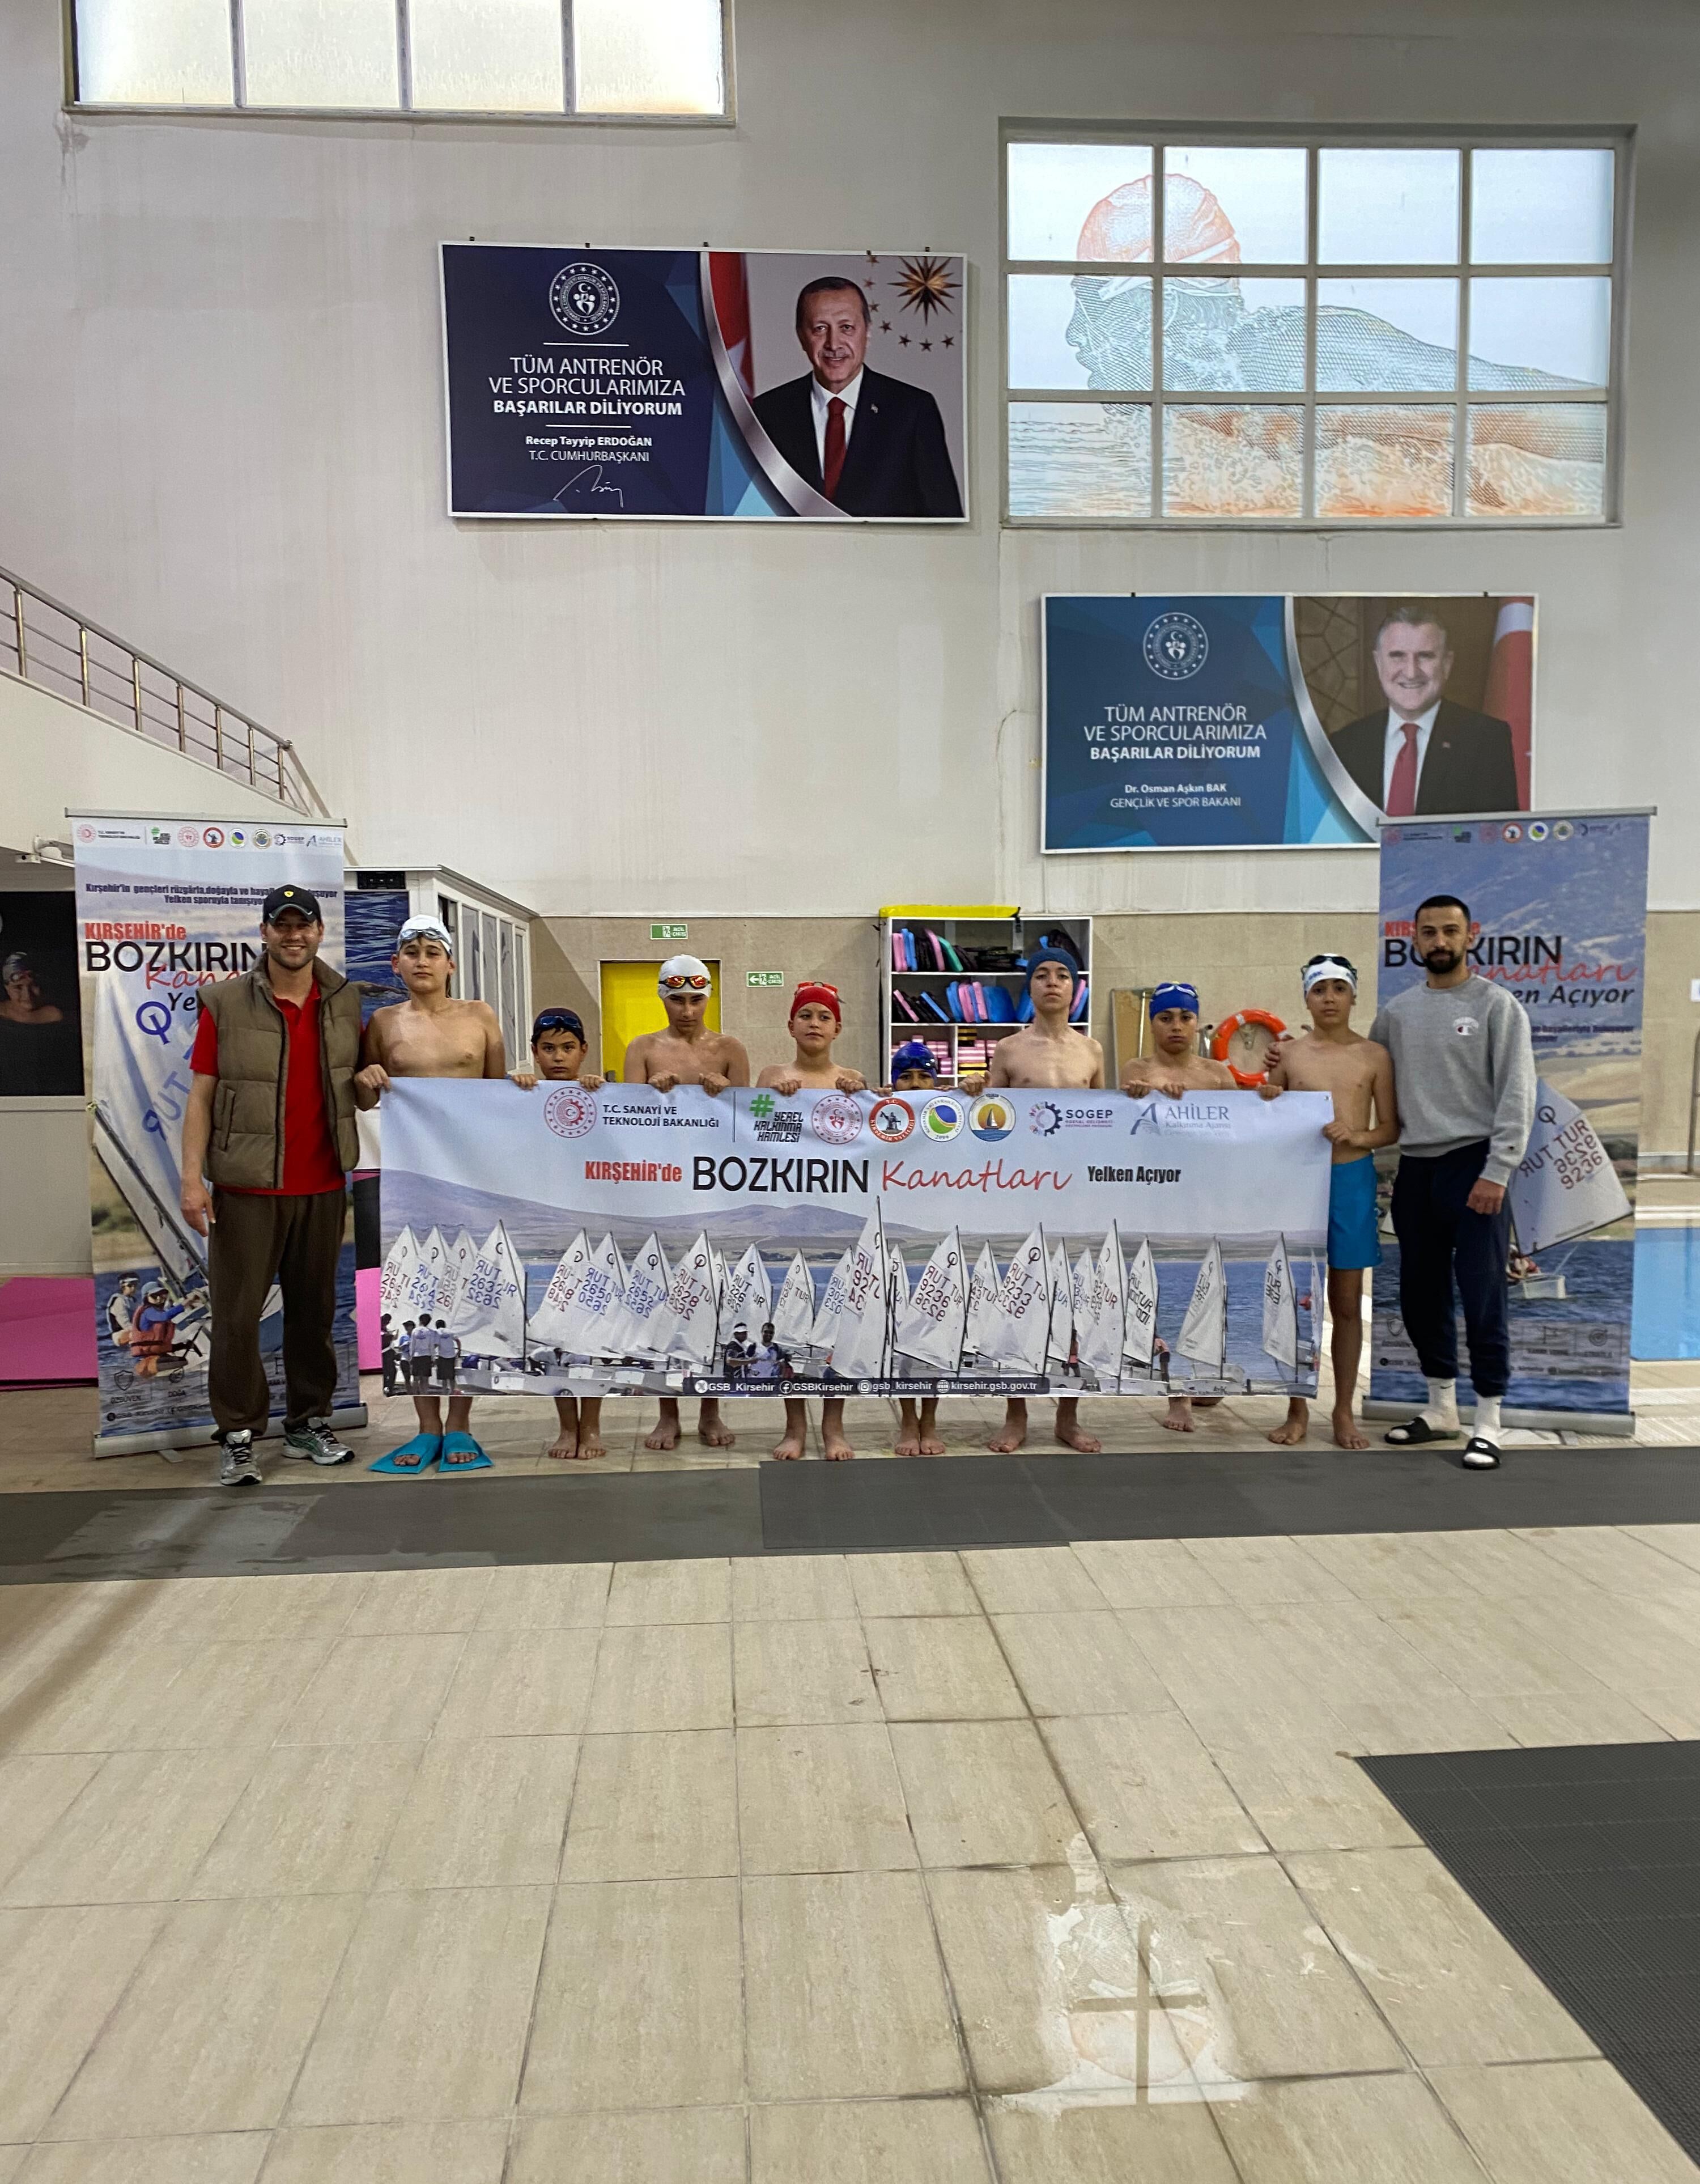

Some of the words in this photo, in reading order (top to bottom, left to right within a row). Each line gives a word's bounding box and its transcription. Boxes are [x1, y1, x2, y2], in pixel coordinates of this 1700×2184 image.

[509, 354, 554, 374] TÜM
[559, 356, 664, 376] ANTRENÖR
[488, 377, 513, 394] VE
[517, 378, 686, 396] SPORCULARIMIZA
[494, 400, 587, 417] BAŞARILAR
[590, 398, 683, 415] DİLİYORUM
[525, 436, 558, 447] Recep
[559, 436, 596, 447] Tayyip
[597, 435, 652, 446] ERDOĞAN
[529, 451, 549, 460] T.C.
[550, 451, 649, 464] CUMHURBAŞKANI
[1104, 703, 1145, 722] TÜM
[1149, 703, 1247, 722] ANTRENÖR
[1083, 726, 1106, 741] VE
[1111, 724, 1267, 741] SPORCULARIMIZA
[1090, 747, 1174, 763] BAŞARILAR
[1176, 744, 1261, 759] DİLİYORUM
[1124, 784, 1139, 793] Dr.
[1141, 784, 1175, 793] Osman
[1178, 783, 1204, 794] Aşkın
[1206, 783, 1227, 792] BAK
[1110, 796, 1154, 809] GENÇLİK
[1157, 798, 1171, 807] VE
[1172, 798, 1200, 807] SPOR
[1202, 796, 1241, 806] BAKANI
[85, 921, 187, 943] KIRŞEHİR'de
[1549, 985, 1635, 1008] Açıyor
[603, 1104, 620, 1114] T.C.
[623, 1104, 662, 1115] SANAYİ
[664, 1106, 677, 1115] VE
[1065, 1109, 1114, 1119] SOGEP
[1165, 1103, 1230, 1121] AHİLER
[602, 1116, 661, 1127] TEKNOLOJİ
[662, 1116, 719, 1128] BAKANLIĞI
[1553, 1119, 1590, 1150] TUR
[584, 1159, 682, 1184] KIRŞEHİR'de
[692, 1155, 869, 1193] BOZKIRIN
[882, 1157, 1073, 1193] Kanatları
[1087, 1165, 1133, 1183] Yelken
[1136, 1166, 1182, 1185] Açıyor
[1560, 1155, 1603, 1190] 9236
[470, 1273, 504, 1296] 2632
[582, 1279, 612, 1304] 2650
[920, 1278, 951, 1308] 9236
[1004, 1275, 1032, 1307] 9233
[793, 1382, 853, 1392] GSBKirsehir
[951, 1381, 1038, 1393] kirsehir.gsb.gov.tr
